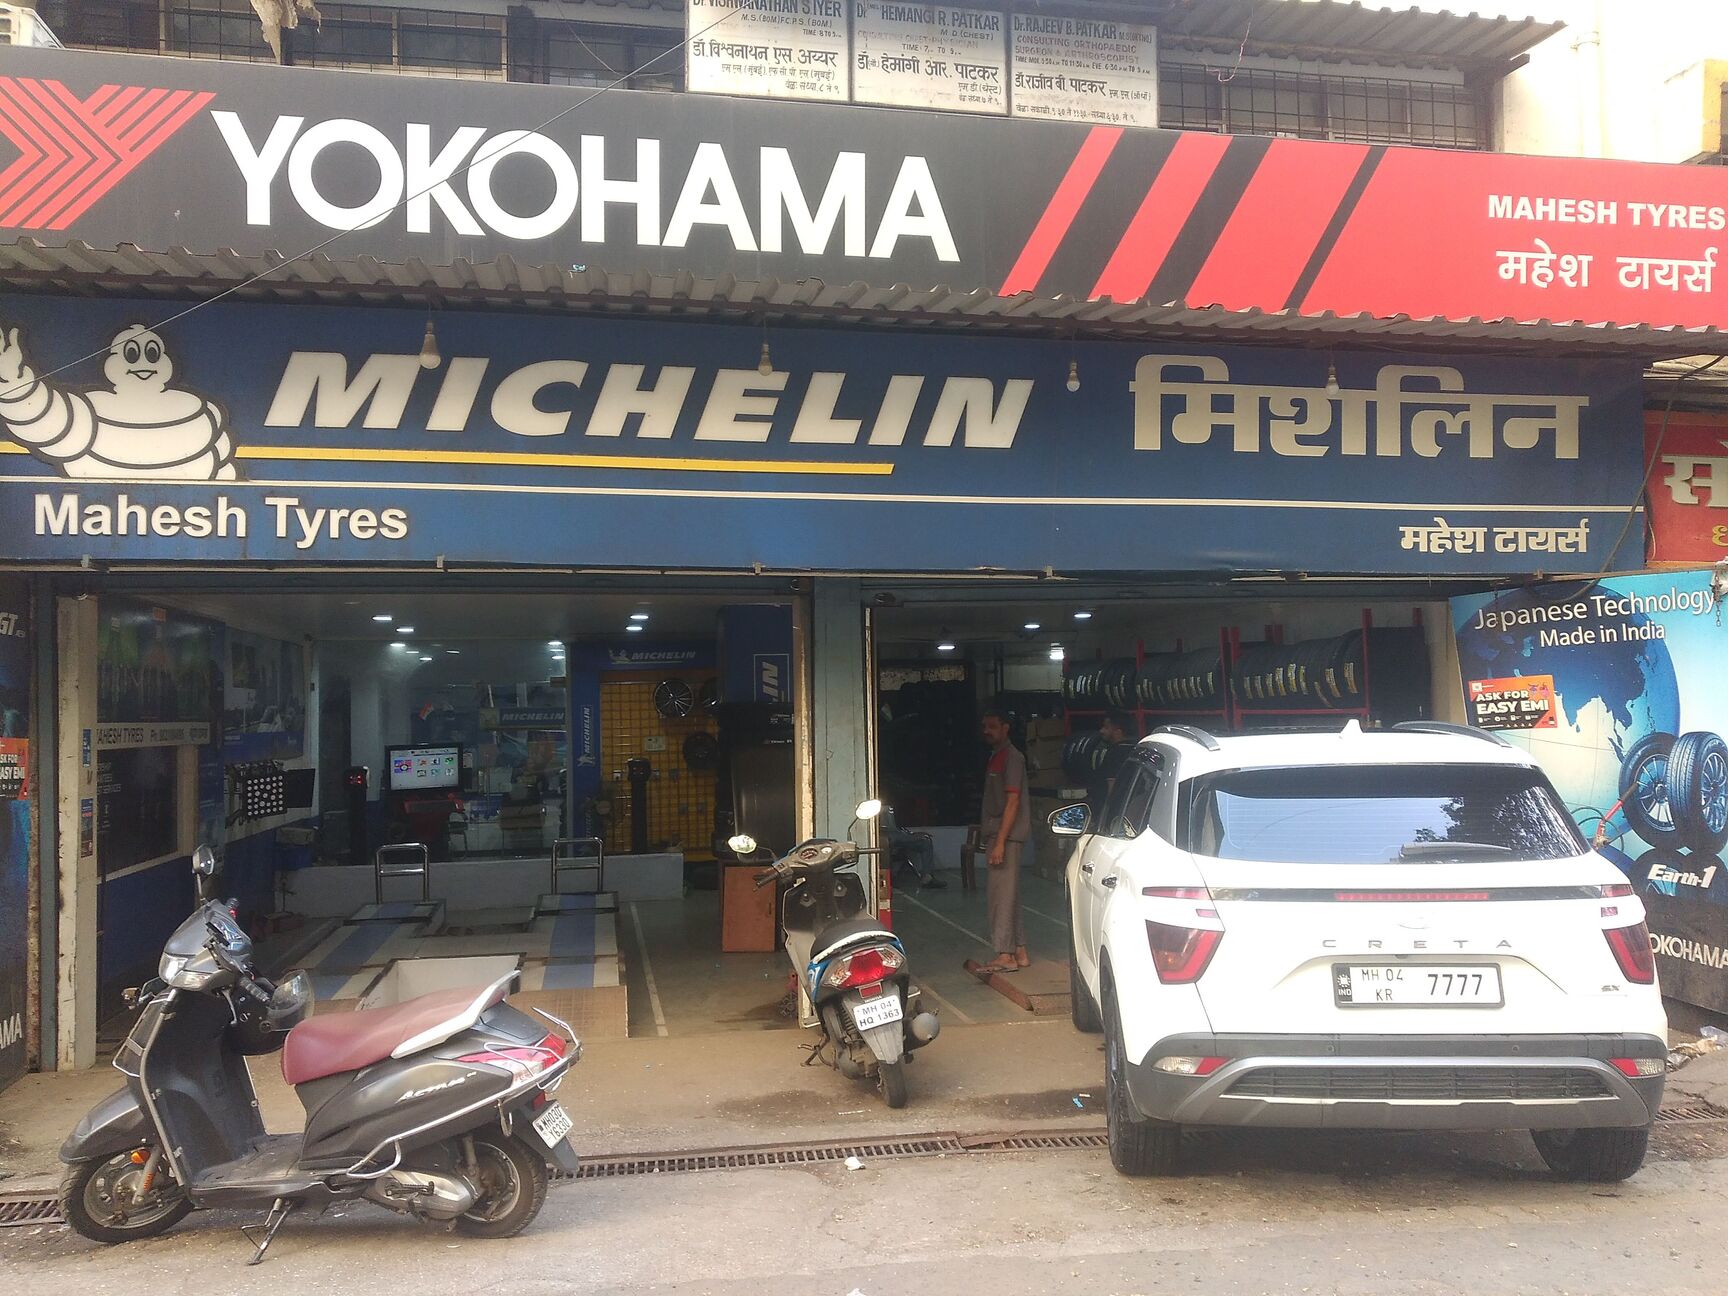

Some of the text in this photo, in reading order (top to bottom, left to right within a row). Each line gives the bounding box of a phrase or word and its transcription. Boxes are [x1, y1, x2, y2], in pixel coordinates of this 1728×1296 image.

[882, 5, 935, 25] HEMANGI
[952, 12, 1000, 31] PATKAR
[710, 39, 769, 61] विश्वनाथन
[798, 49, 839, 68] अय्यर
[1015, 45, 1053, 56] SURGEON
[1017, 35, 1137, 53] CONSULTING ORTHOPAEDIC
[881, 52, 920, 74] हेमांगी
[954, 62, 999, 83] पाटकर
[1069, 78, 1108, 96] पाटकर
[211, 111, 961, 263] YOKOHAMA
[1488, 194, 1726, 231] MAHESH TYRES
[1495, 237, 1719, 293] महेश टायर्स
[263, 351, 1035, 449] MICHELIN
[1128, 354, 1590, 460] मिशलिन
[34, 494, 408, 549] Mahesh Tyres
[1399, 516, 1591, 554] महेश टायर्स
[1474, 586, 1716, 632] Japanese Technology
[1539, 620, 1666, 648] Made in India
[631, 649, 697, 661] MICHELIN
[1476, 689, 1529, 702] ASK FOR
[1476, 699, 1550, 715] EASY EMI
[502, 711, 565, 721] MICHELIN
[96, 727, 122, 746] AHESH
[1647, 863, 1718, 889] Earth-1
[1322, 939, 1513, 949] CRETA
[1648, 932, 1728, 969] OKOHAMA
[1361, 968, 1404, 982] MH 04
[1427, 974, 1483, 996] 7777
[1375, 988, 1393, 1001] KR
[859, 1008, 900, 1027] HQ 1363
[862, 1001, 893, 1015] MH 04
